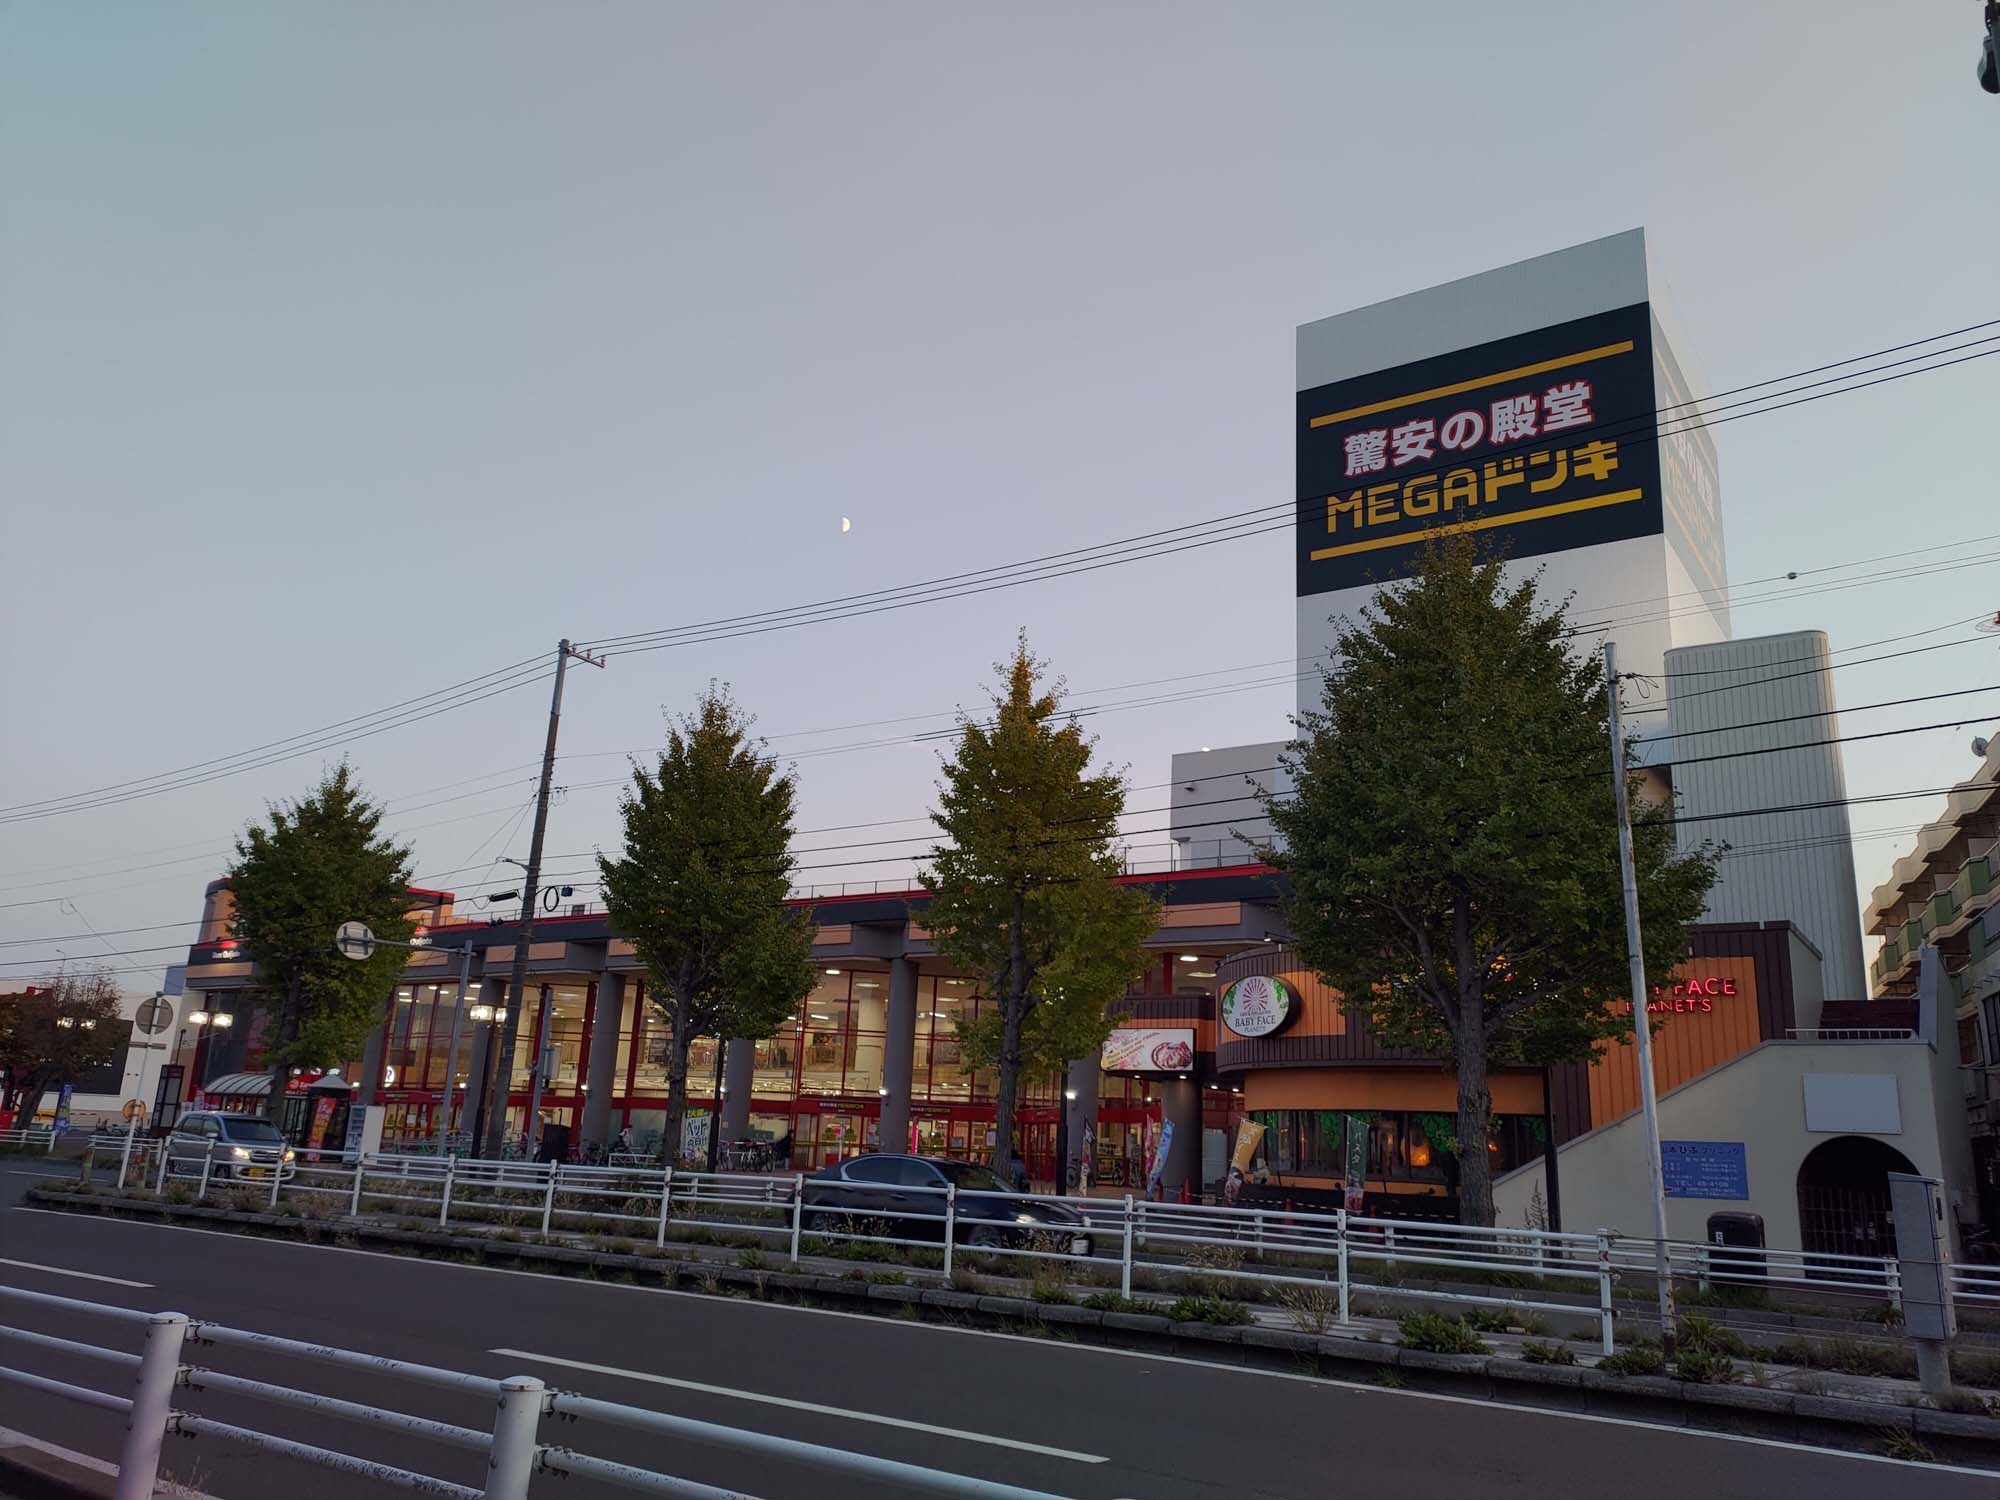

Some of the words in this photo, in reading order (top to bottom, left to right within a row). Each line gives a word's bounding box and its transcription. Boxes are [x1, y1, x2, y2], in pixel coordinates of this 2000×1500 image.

[1341, 380, 1594, 477] 驚安の殿堂
[1326, 440, 1620, 534] MEGAドンキ
[1235, 1017, 1255, 1027] BABY
[1257, 1014, 1276, 1025] FACE
